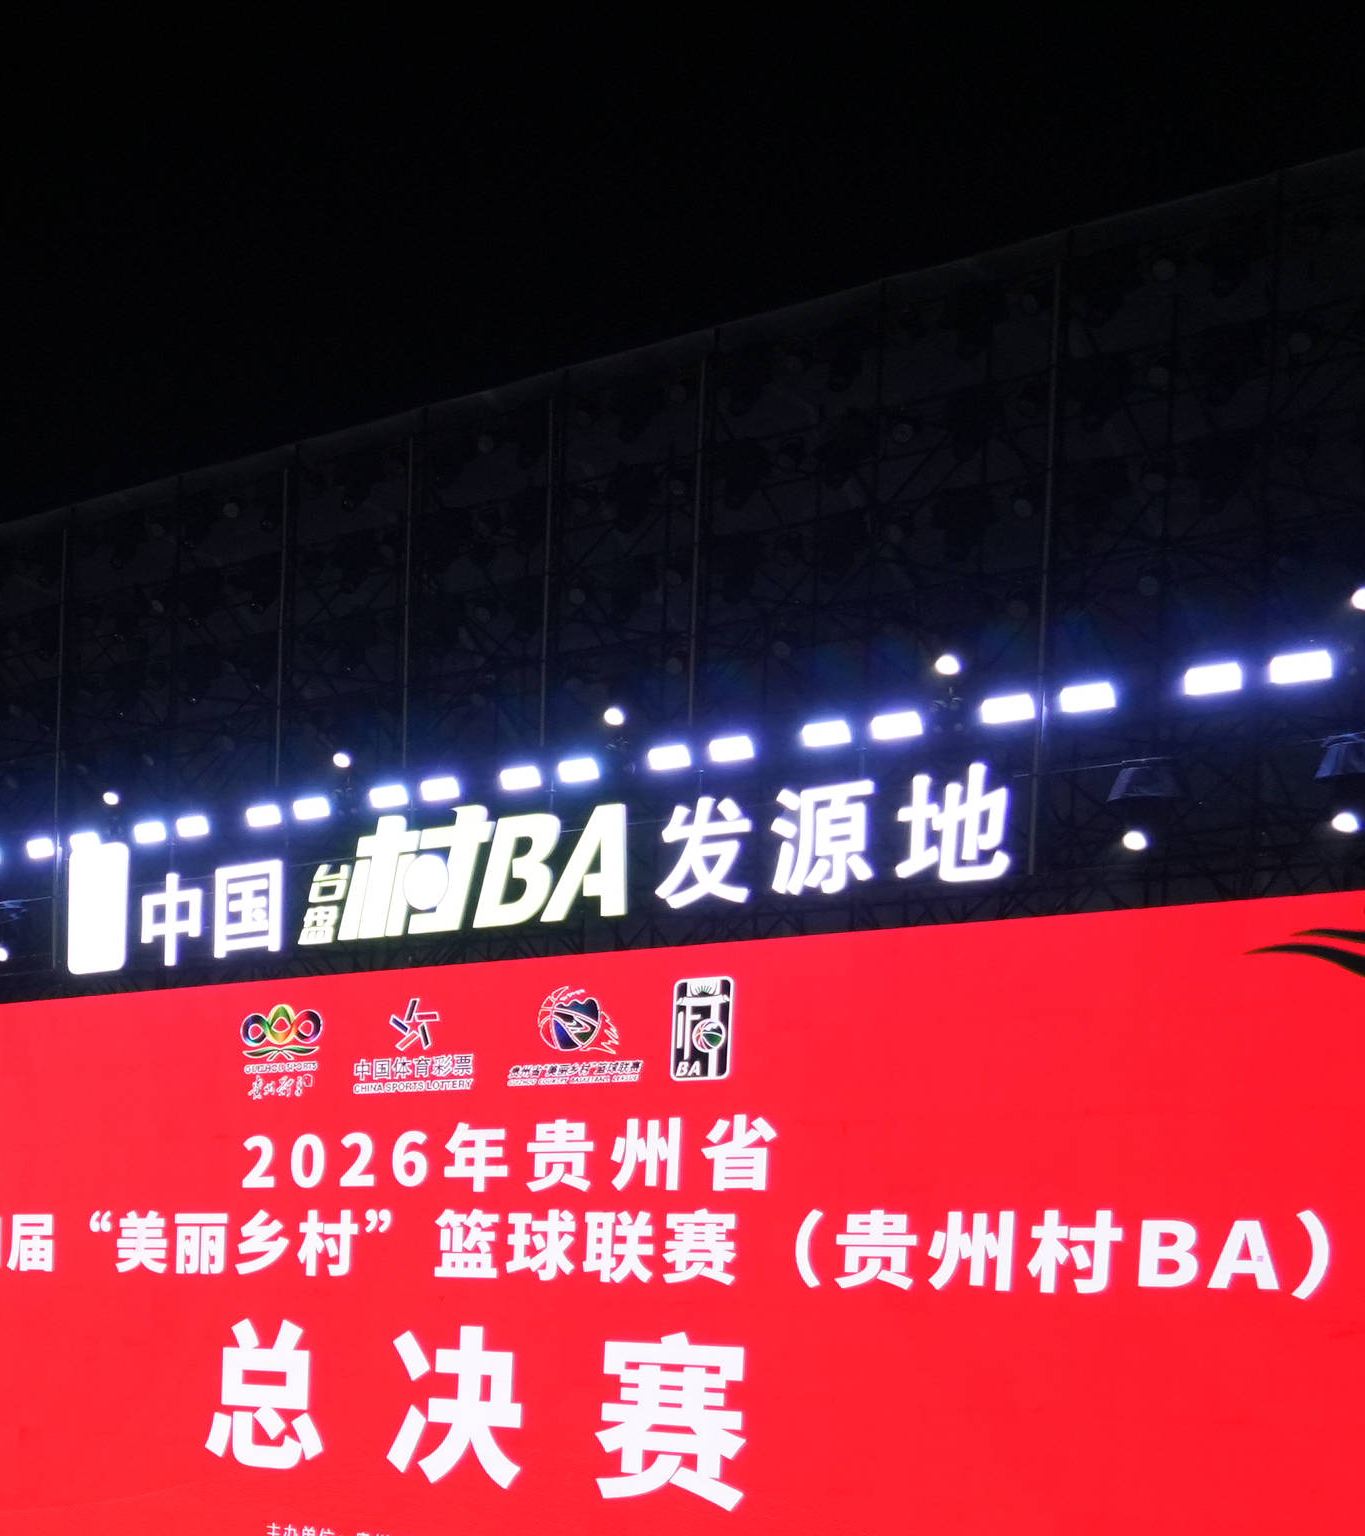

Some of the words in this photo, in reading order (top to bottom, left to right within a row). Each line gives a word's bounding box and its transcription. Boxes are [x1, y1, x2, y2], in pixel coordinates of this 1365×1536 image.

[141, 858, 283, 967] 中国
[297, 863, 352, 945] 台盘
[338, 803, 628, 942] 村BA
[658, 761, 1013, 911] 发源地
[353, 1054, 474, 1081] 中国体育彩票
[353, 1083, 384, 1095] CHINA
[385, 1081, 424, 1093] SPORTS
[426, 1078, 474, 1092] LOTTERY
[241, 1114, 778, 1193] 2026年贵州省
[205, 1318, 747, 1512] 总决赛
